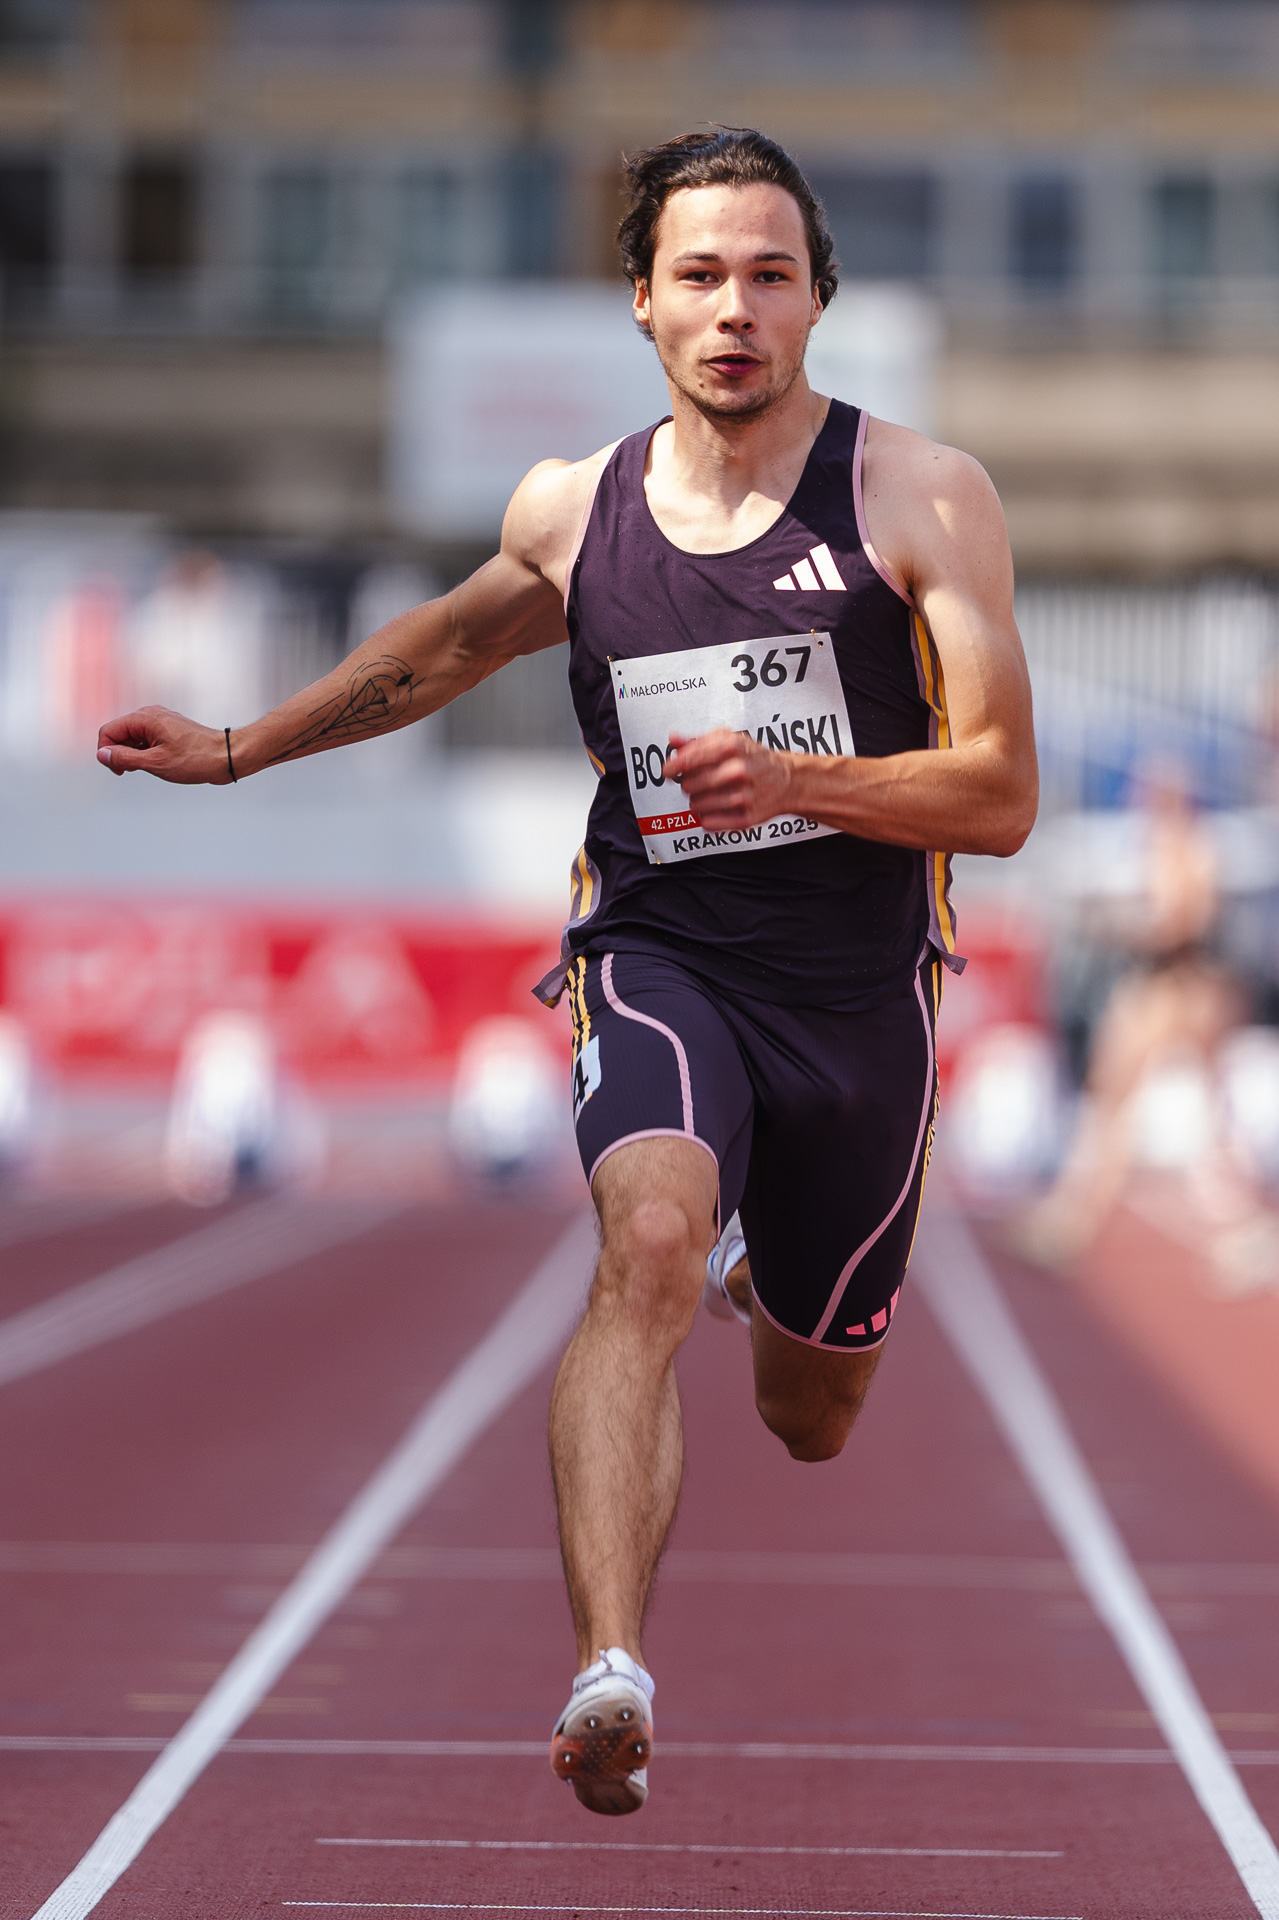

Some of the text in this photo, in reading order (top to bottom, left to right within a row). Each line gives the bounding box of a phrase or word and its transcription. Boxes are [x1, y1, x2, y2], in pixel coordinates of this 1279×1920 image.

[730, 645, 811, 692] 367
[630, 676, 707, 698] MAŁOPOLSKA
[630, 713, 843, 790] BOŃSKI
[650, 813, 697, 831] 42. PZLA
[767, 818, 819, 839] 2025
